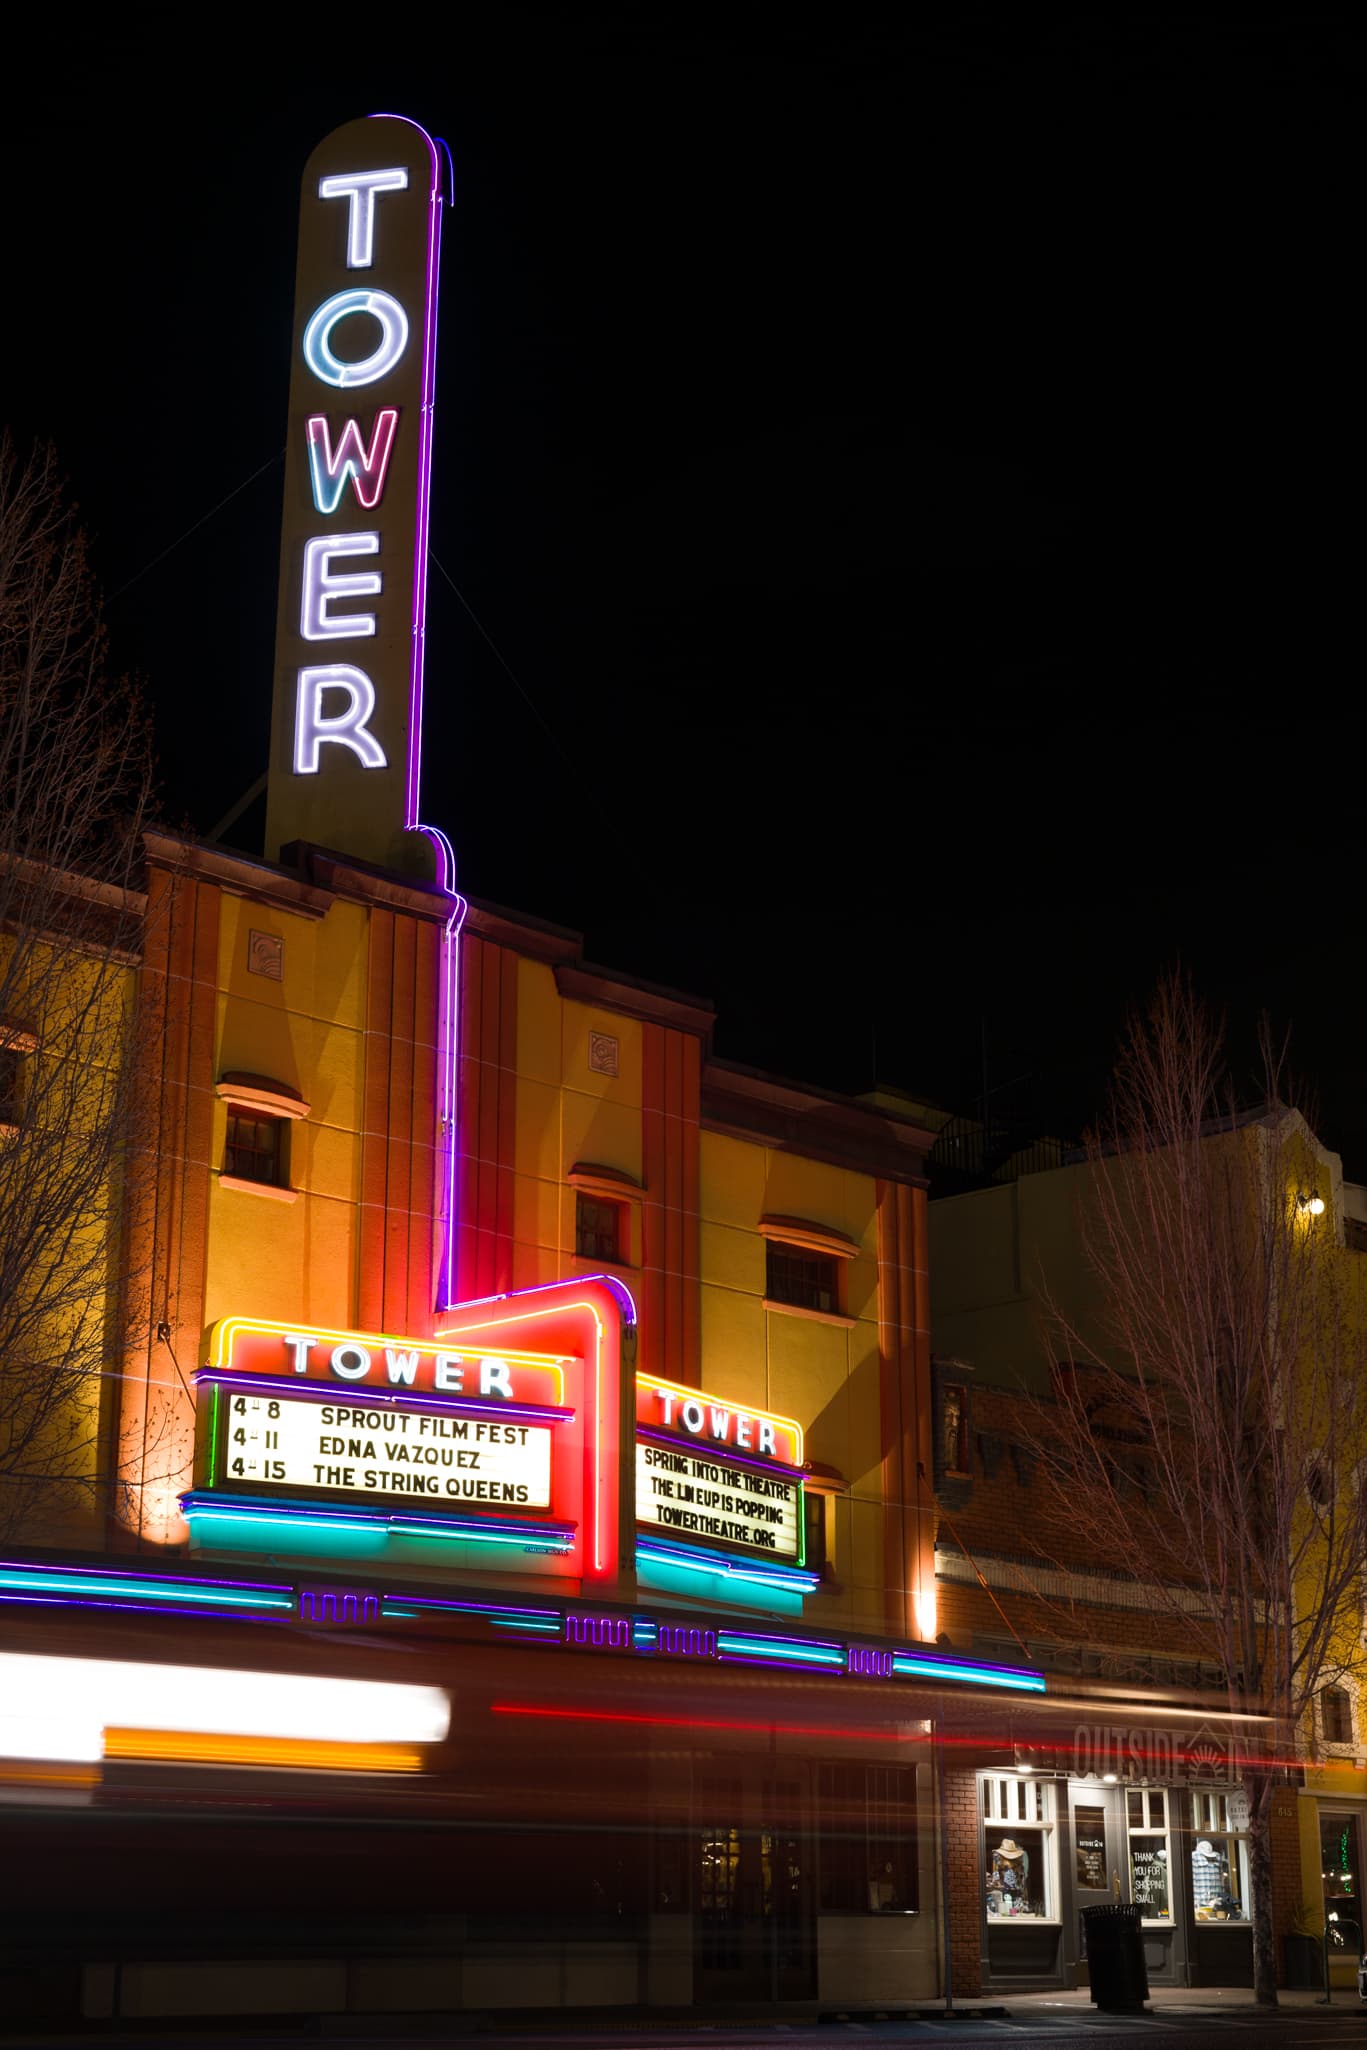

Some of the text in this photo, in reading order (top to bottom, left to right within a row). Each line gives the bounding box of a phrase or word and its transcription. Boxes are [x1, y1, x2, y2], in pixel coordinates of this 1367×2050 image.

[292, 166, 411, 775] TOWER
[284, 1336, 514, 1398] TOWER
[320, 1407, 411, 1434] SPROUT
[418, 1417, 469, 1439] FILM
[475, 1424, 529, 1446] FEST
[653, 1389, 777, 1457] TOWER
[319, 1436, 377, 1460] EDNA
[385, 1443, 481, 1470] VAZQUEZ
[313, 1464, 355, 1487] THE
[364, 1470, 439, 1494] STRING
[445, 1478, 529, 1502] QUEENS
[645, 1448, 791, 1501] SPRING INTO THE THEATRE
[651, 1476, 674, 1498] THE
[721, 1494, 733, 1512] IS
[735, 1497, 783, 1525] POPPING
[1073, 1725, 1186, 1785] OUTSIDE
[1133, 1852, 1154, 1862] THANK
[1134, 1866, 1161, 1876] YOU FOR
[1135, 1880, 1165, 1890] SHOPPING
[1135, 1894, 1156, 1904] SMALL
